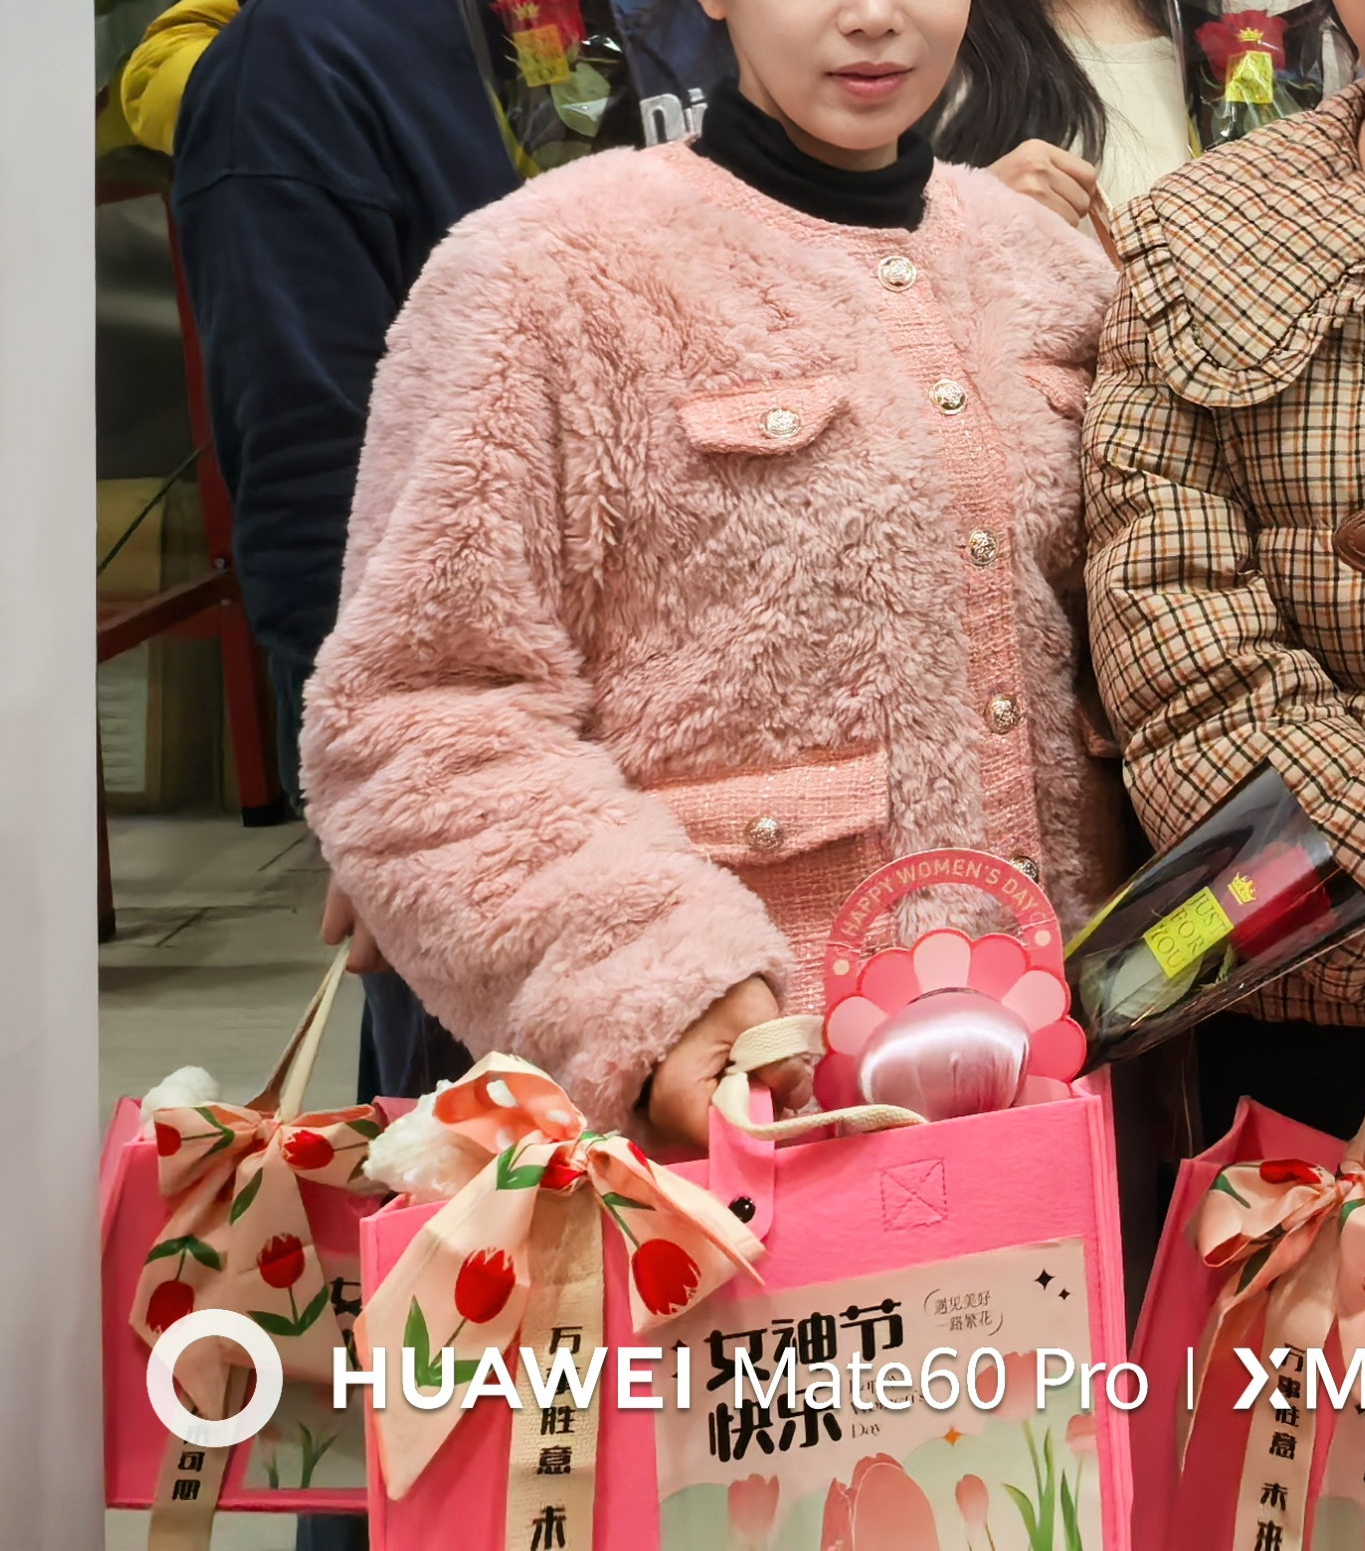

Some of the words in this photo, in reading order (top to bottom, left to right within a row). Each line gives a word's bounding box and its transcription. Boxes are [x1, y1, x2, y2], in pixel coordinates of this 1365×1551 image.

[839, 876, 895, 937] HAPPY
[895, 857, 1001, 886] WOMEN'S
[1001, 877, 1038, 912] DAY
[1187, 892, 1229, 936] JUST
[1150, 923, 1187, 968] YOU
[1170, 907, 1206, 955] FOR
[704, 1298, 903, 1391] 女神节
[707, 1386, 842, 1462] 快乐
